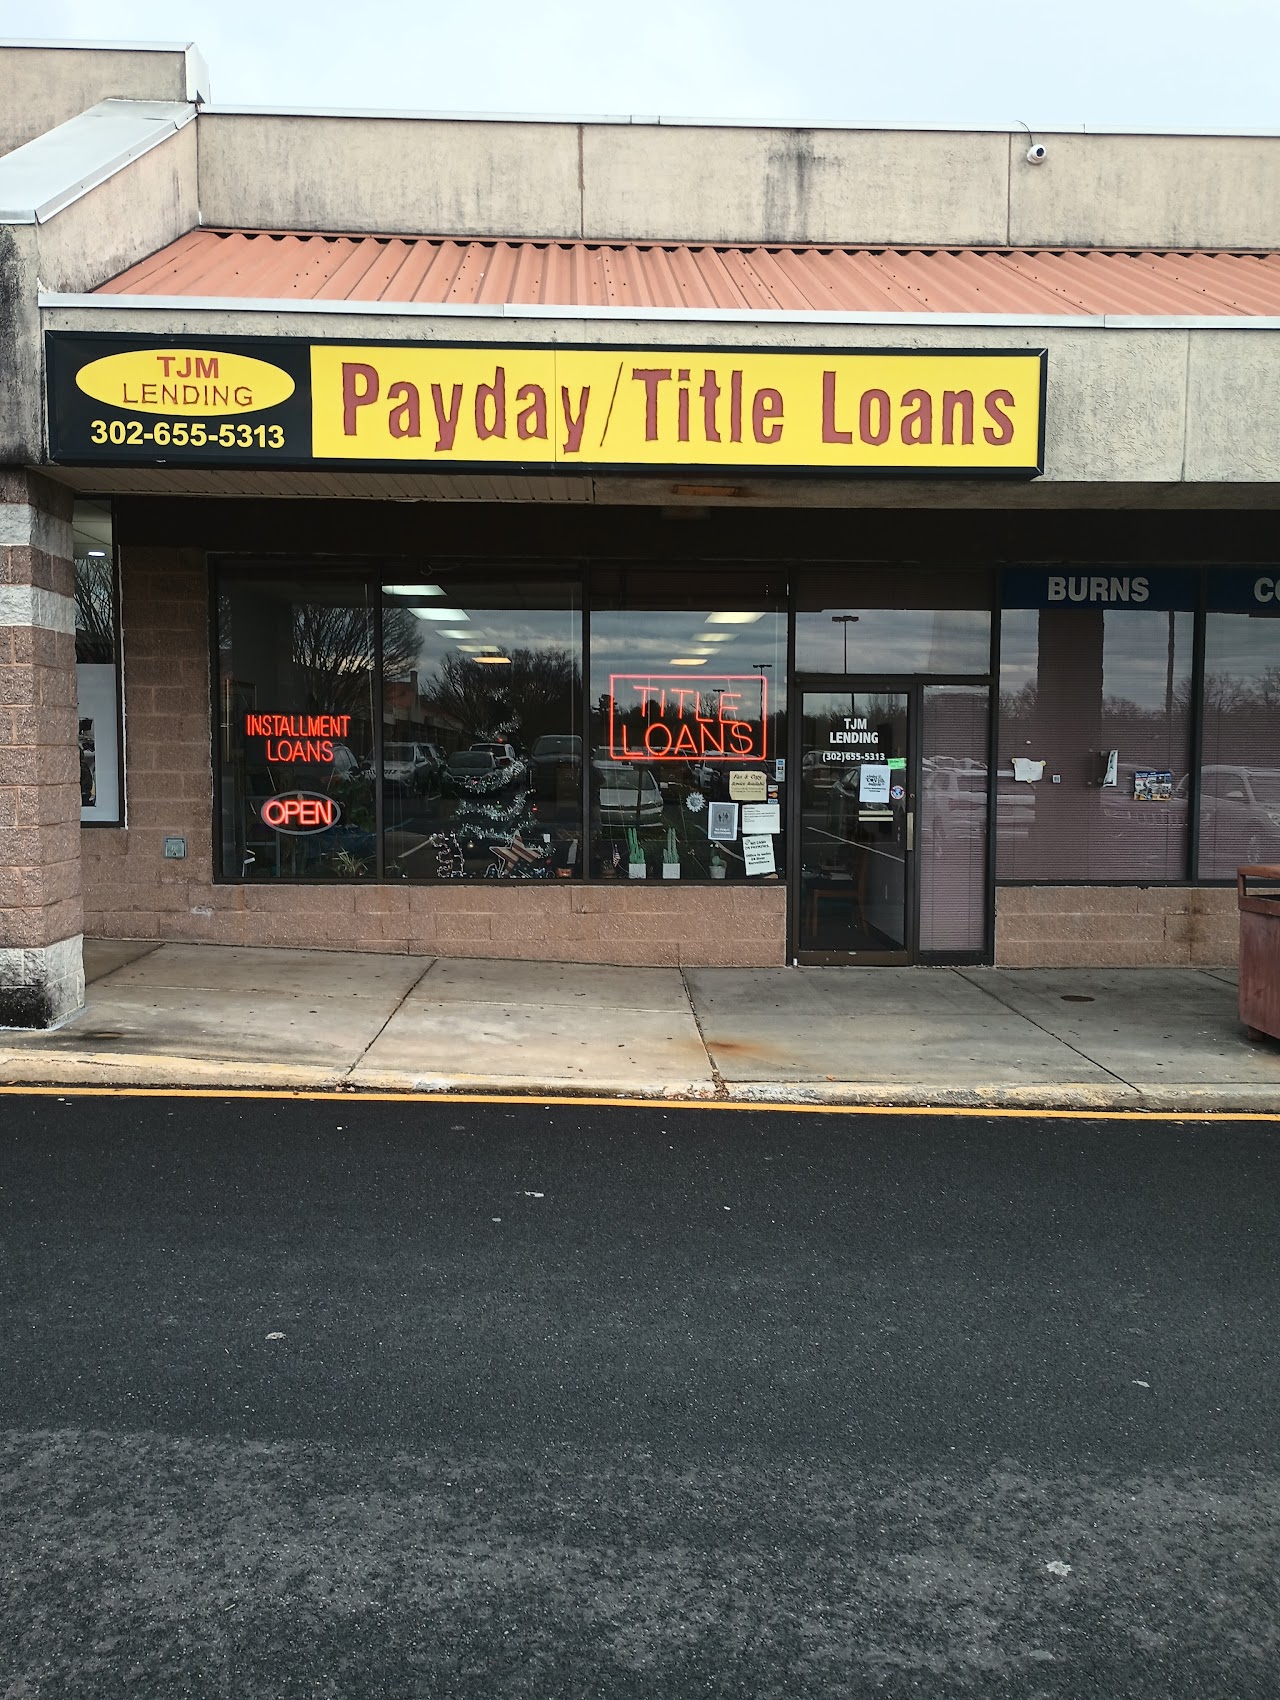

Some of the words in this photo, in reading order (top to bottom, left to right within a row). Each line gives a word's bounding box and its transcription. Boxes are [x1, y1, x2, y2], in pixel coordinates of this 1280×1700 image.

[157, 356, 220, 379] TJM
[122, 382, 254, 406] LENDING
[341, 361, 785, 454] Payday/Title
[821, 370, 1017, 446] Loans
[90, 420, 286, 449] 302-655-5313
[1047, 576, 1150, 602] BURNS
[633, 685, 742, 724] TITLE
[246, 714, 351, 737] INSTALLMENT
[843, 718, 867, 730] TJM
[622, 722, 754, 756] LOANS
[829, 731, 879, 744] LENDING
[266, 740, 334, 763] LOANS
[265, 800, 332, 825] OPEN
